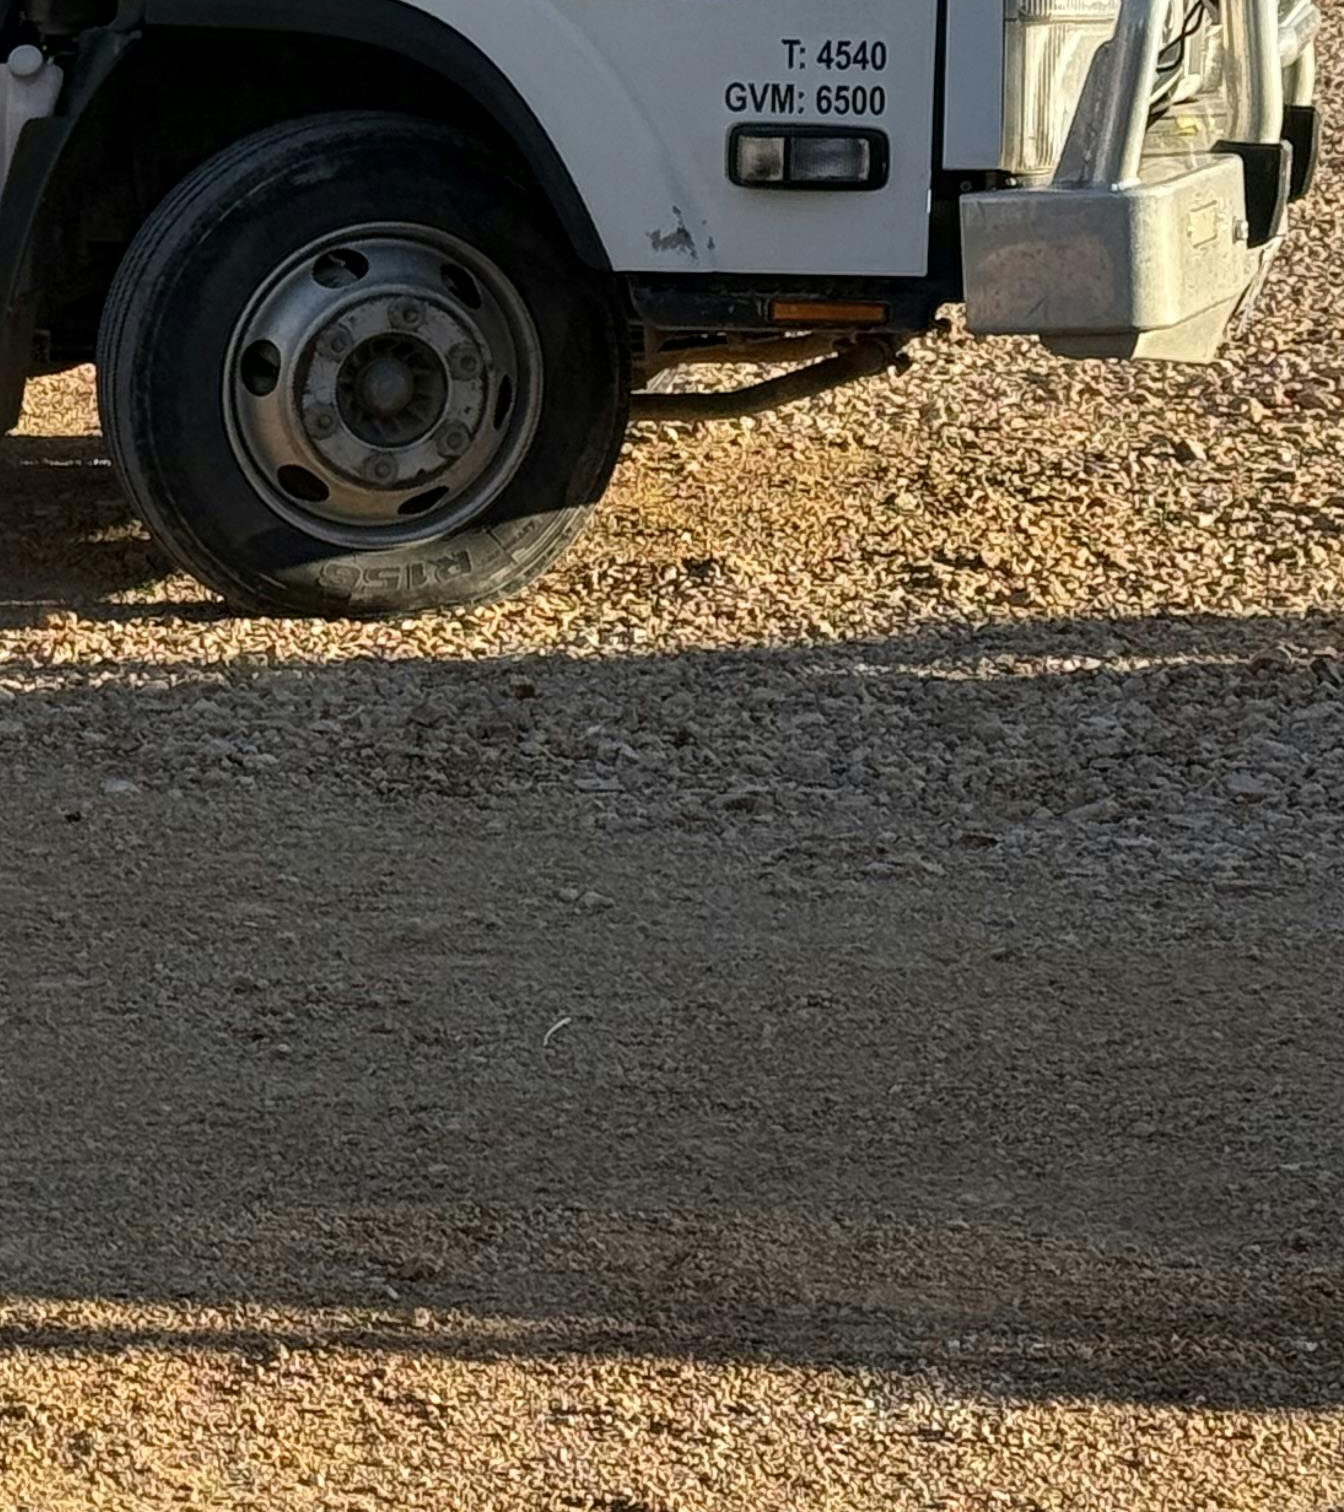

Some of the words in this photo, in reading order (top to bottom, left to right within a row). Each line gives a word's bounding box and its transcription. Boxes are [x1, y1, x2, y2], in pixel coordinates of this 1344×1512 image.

[781, 39, 806, 71] T:
[815, 39, 888, 72] 4540
[724, 81, 805, 116] GVM:
[815, 84, 887, 117] 6500
